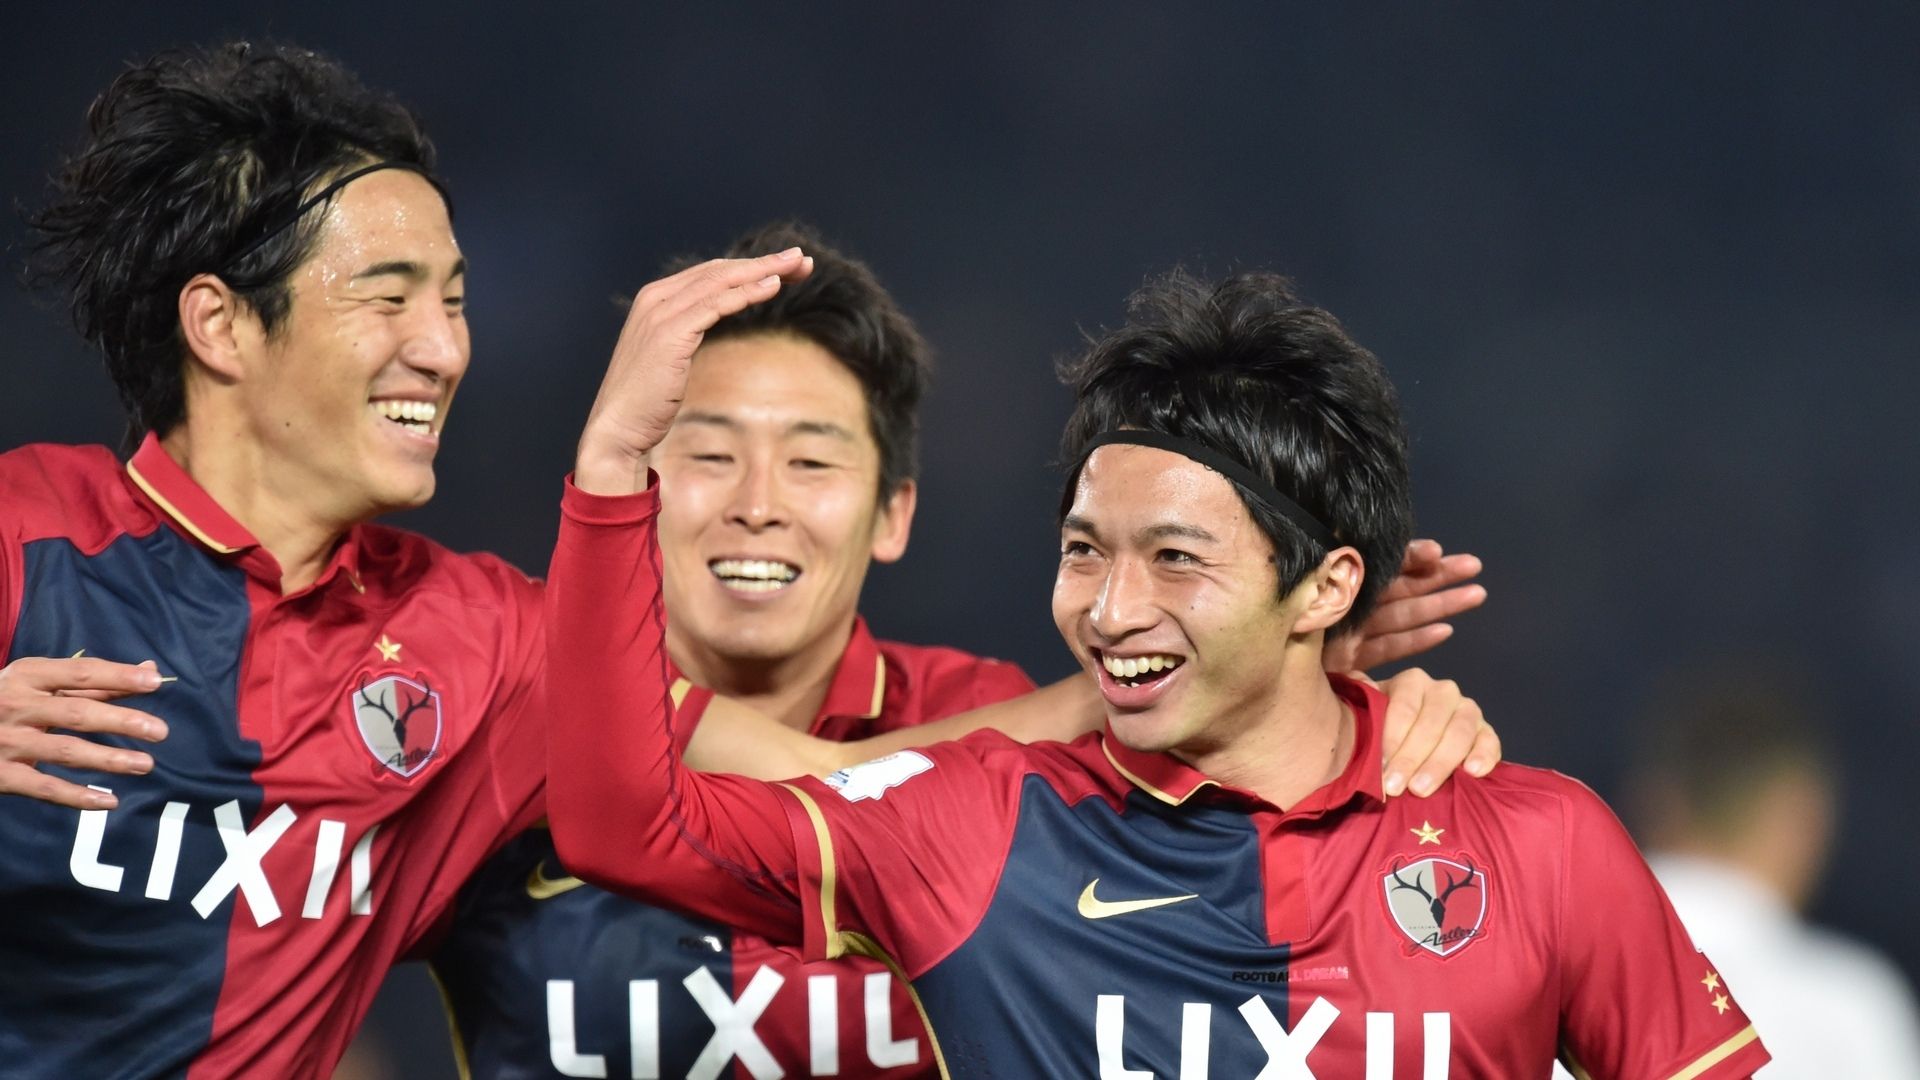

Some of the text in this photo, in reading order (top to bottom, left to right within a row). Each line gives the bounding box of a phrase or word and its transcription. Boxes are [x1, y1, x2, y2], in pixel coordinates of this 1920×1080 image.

[1232, 966, 1349, 982] FOOTBALL DREAM
[546, 964, 919, 1080] LIXIL
